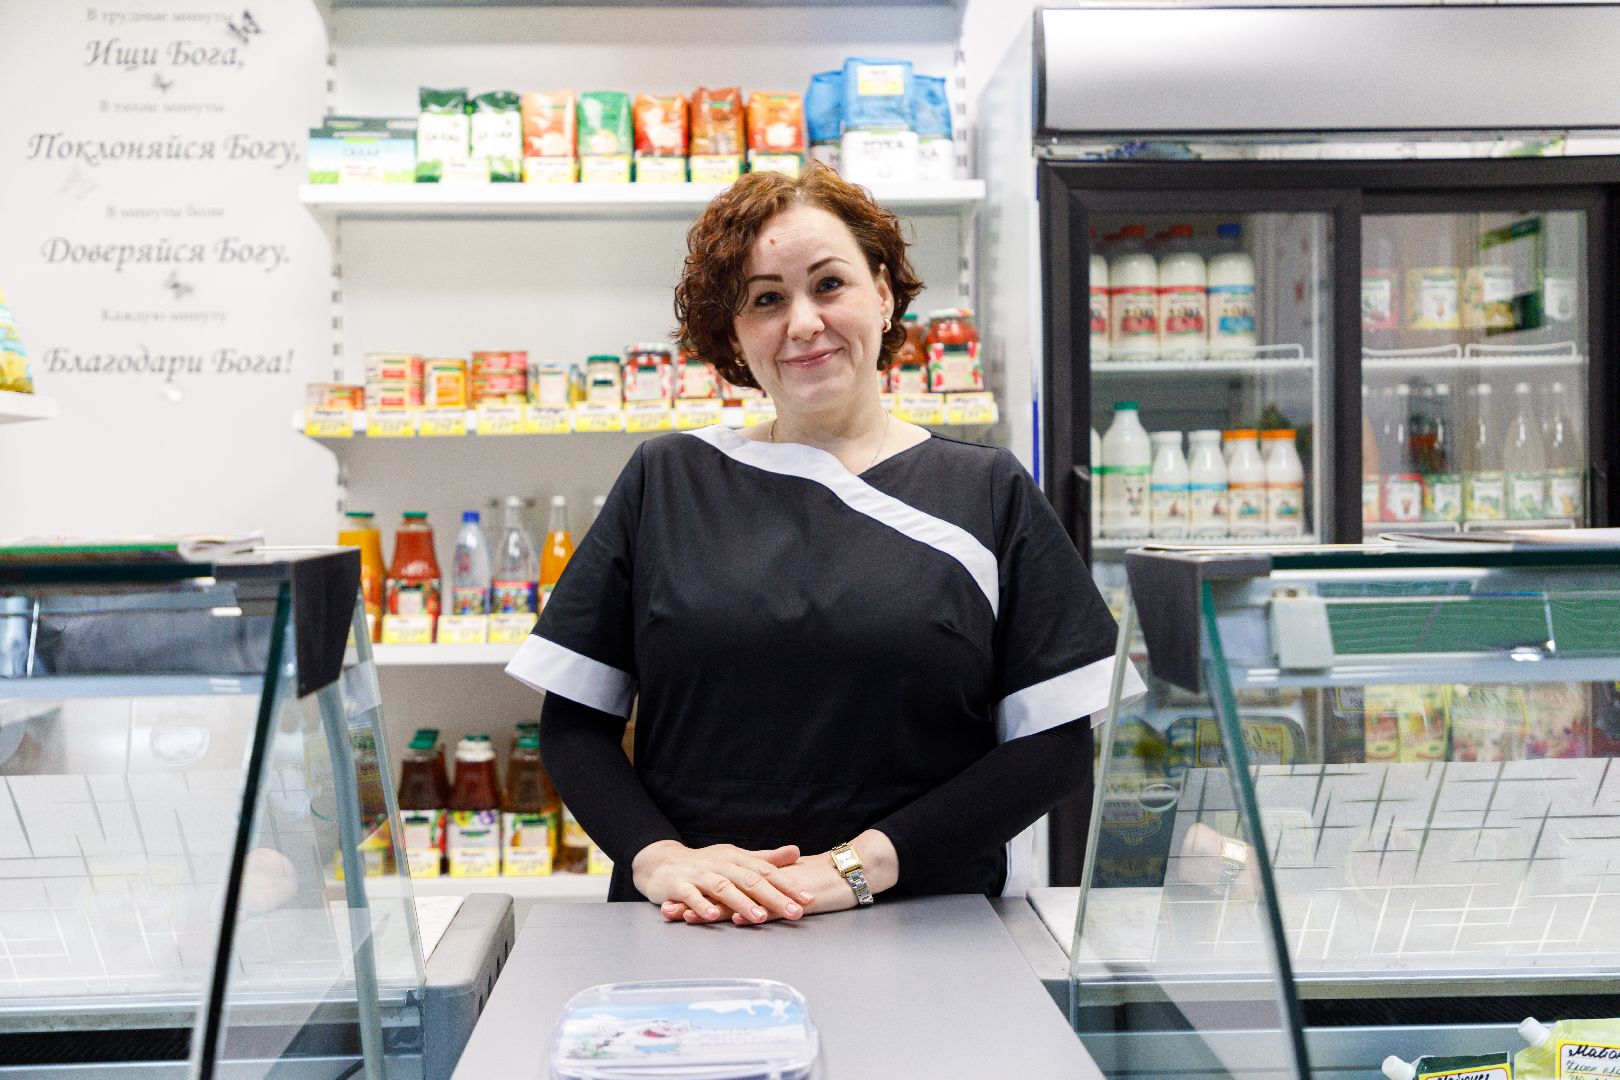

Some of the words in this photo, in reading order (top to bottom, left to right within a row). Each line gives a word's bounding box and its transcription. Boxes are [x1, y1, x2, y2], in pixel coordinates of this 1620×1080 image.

[84, 38, 157, 72] Ищи
[166, 40, 245, 69] Бога,
[26, 133, 216, 167] Поклоняйся
[223, 133, 302, 169] Богу,
[41, 236, 206, 272] Доверяйся
[214, 237, 291, 273] Богу.
[43, 344, 203, 383] Благодари
[210, 347, 294, 375] Бога!
